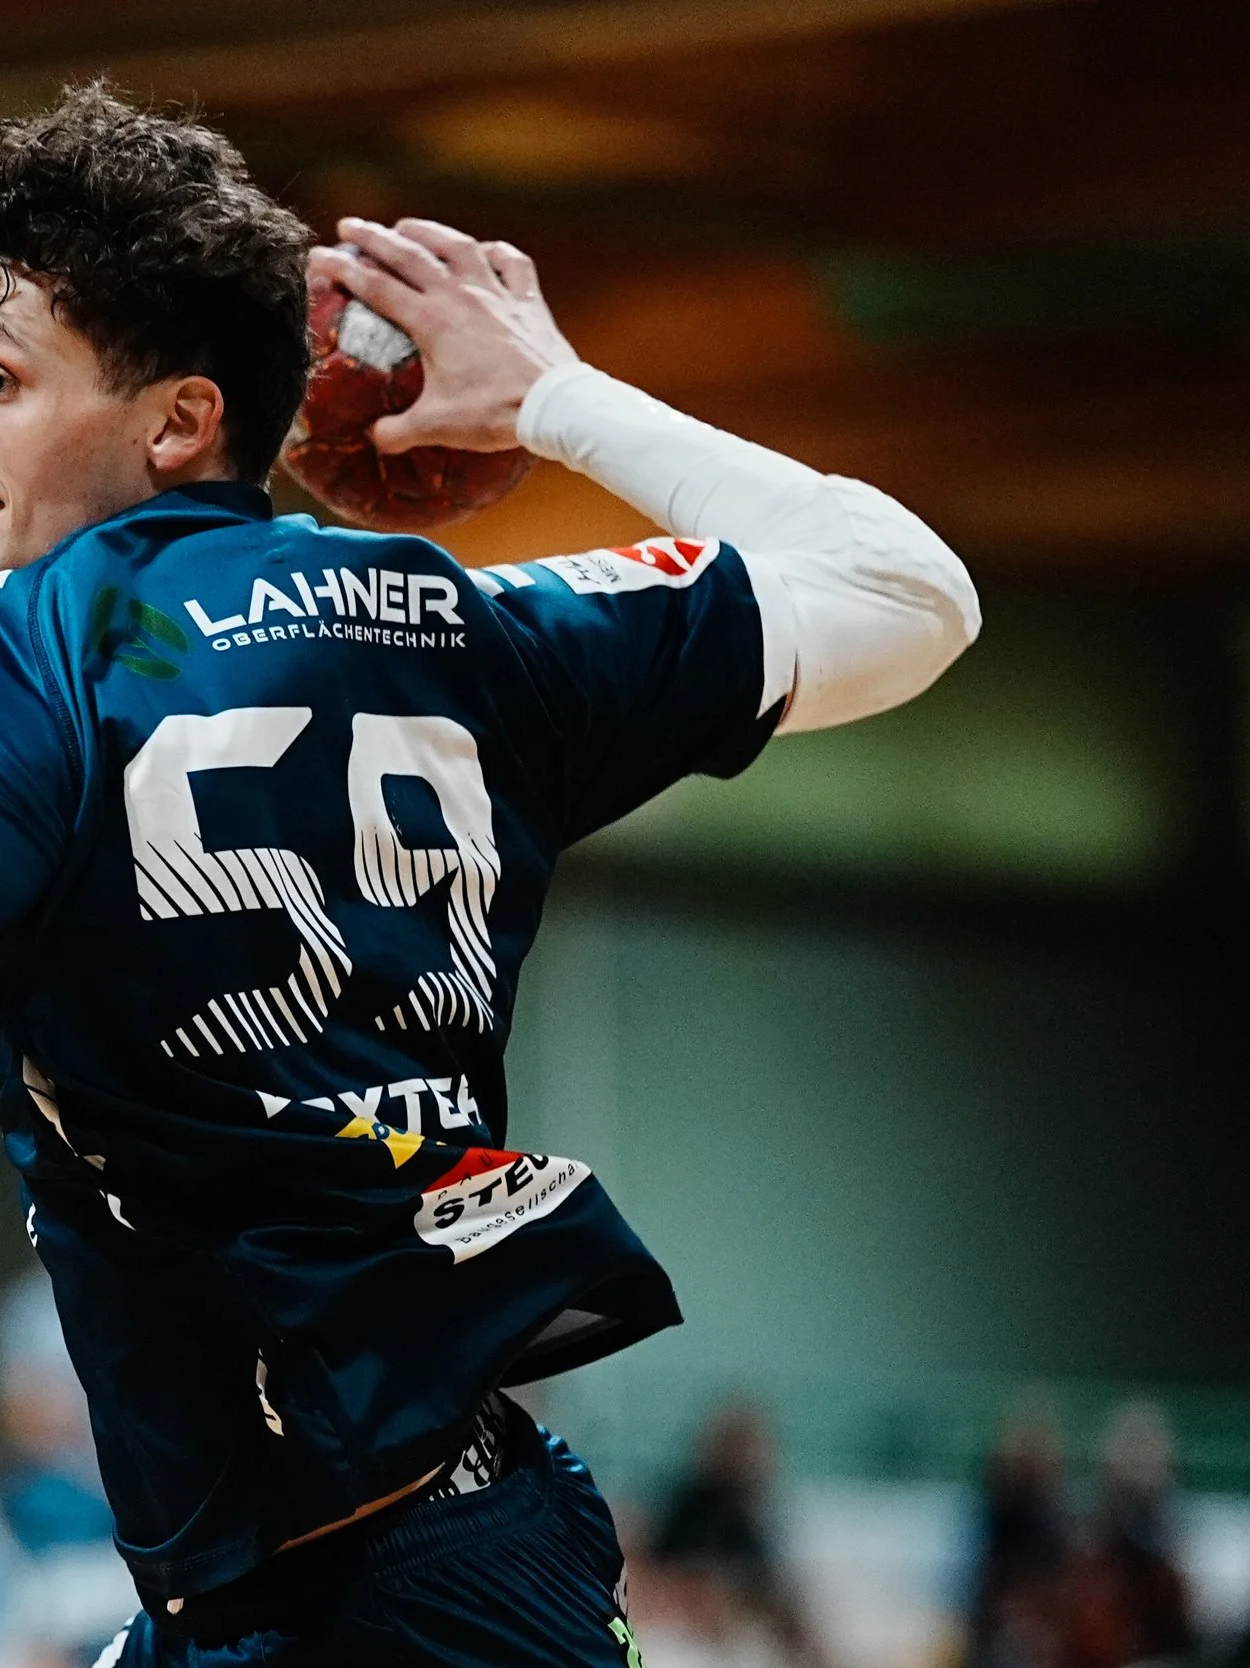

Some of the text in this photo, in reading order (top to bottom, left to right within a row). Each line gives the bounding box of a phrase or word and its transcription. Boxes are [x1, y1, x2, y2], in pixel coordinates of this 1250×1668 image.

[183, 566, 466, 638] LAHNER
[211, 619, 467, 652] OBERFLÄCHENTECHNIK
[124, 706, 500, 1058] 59
